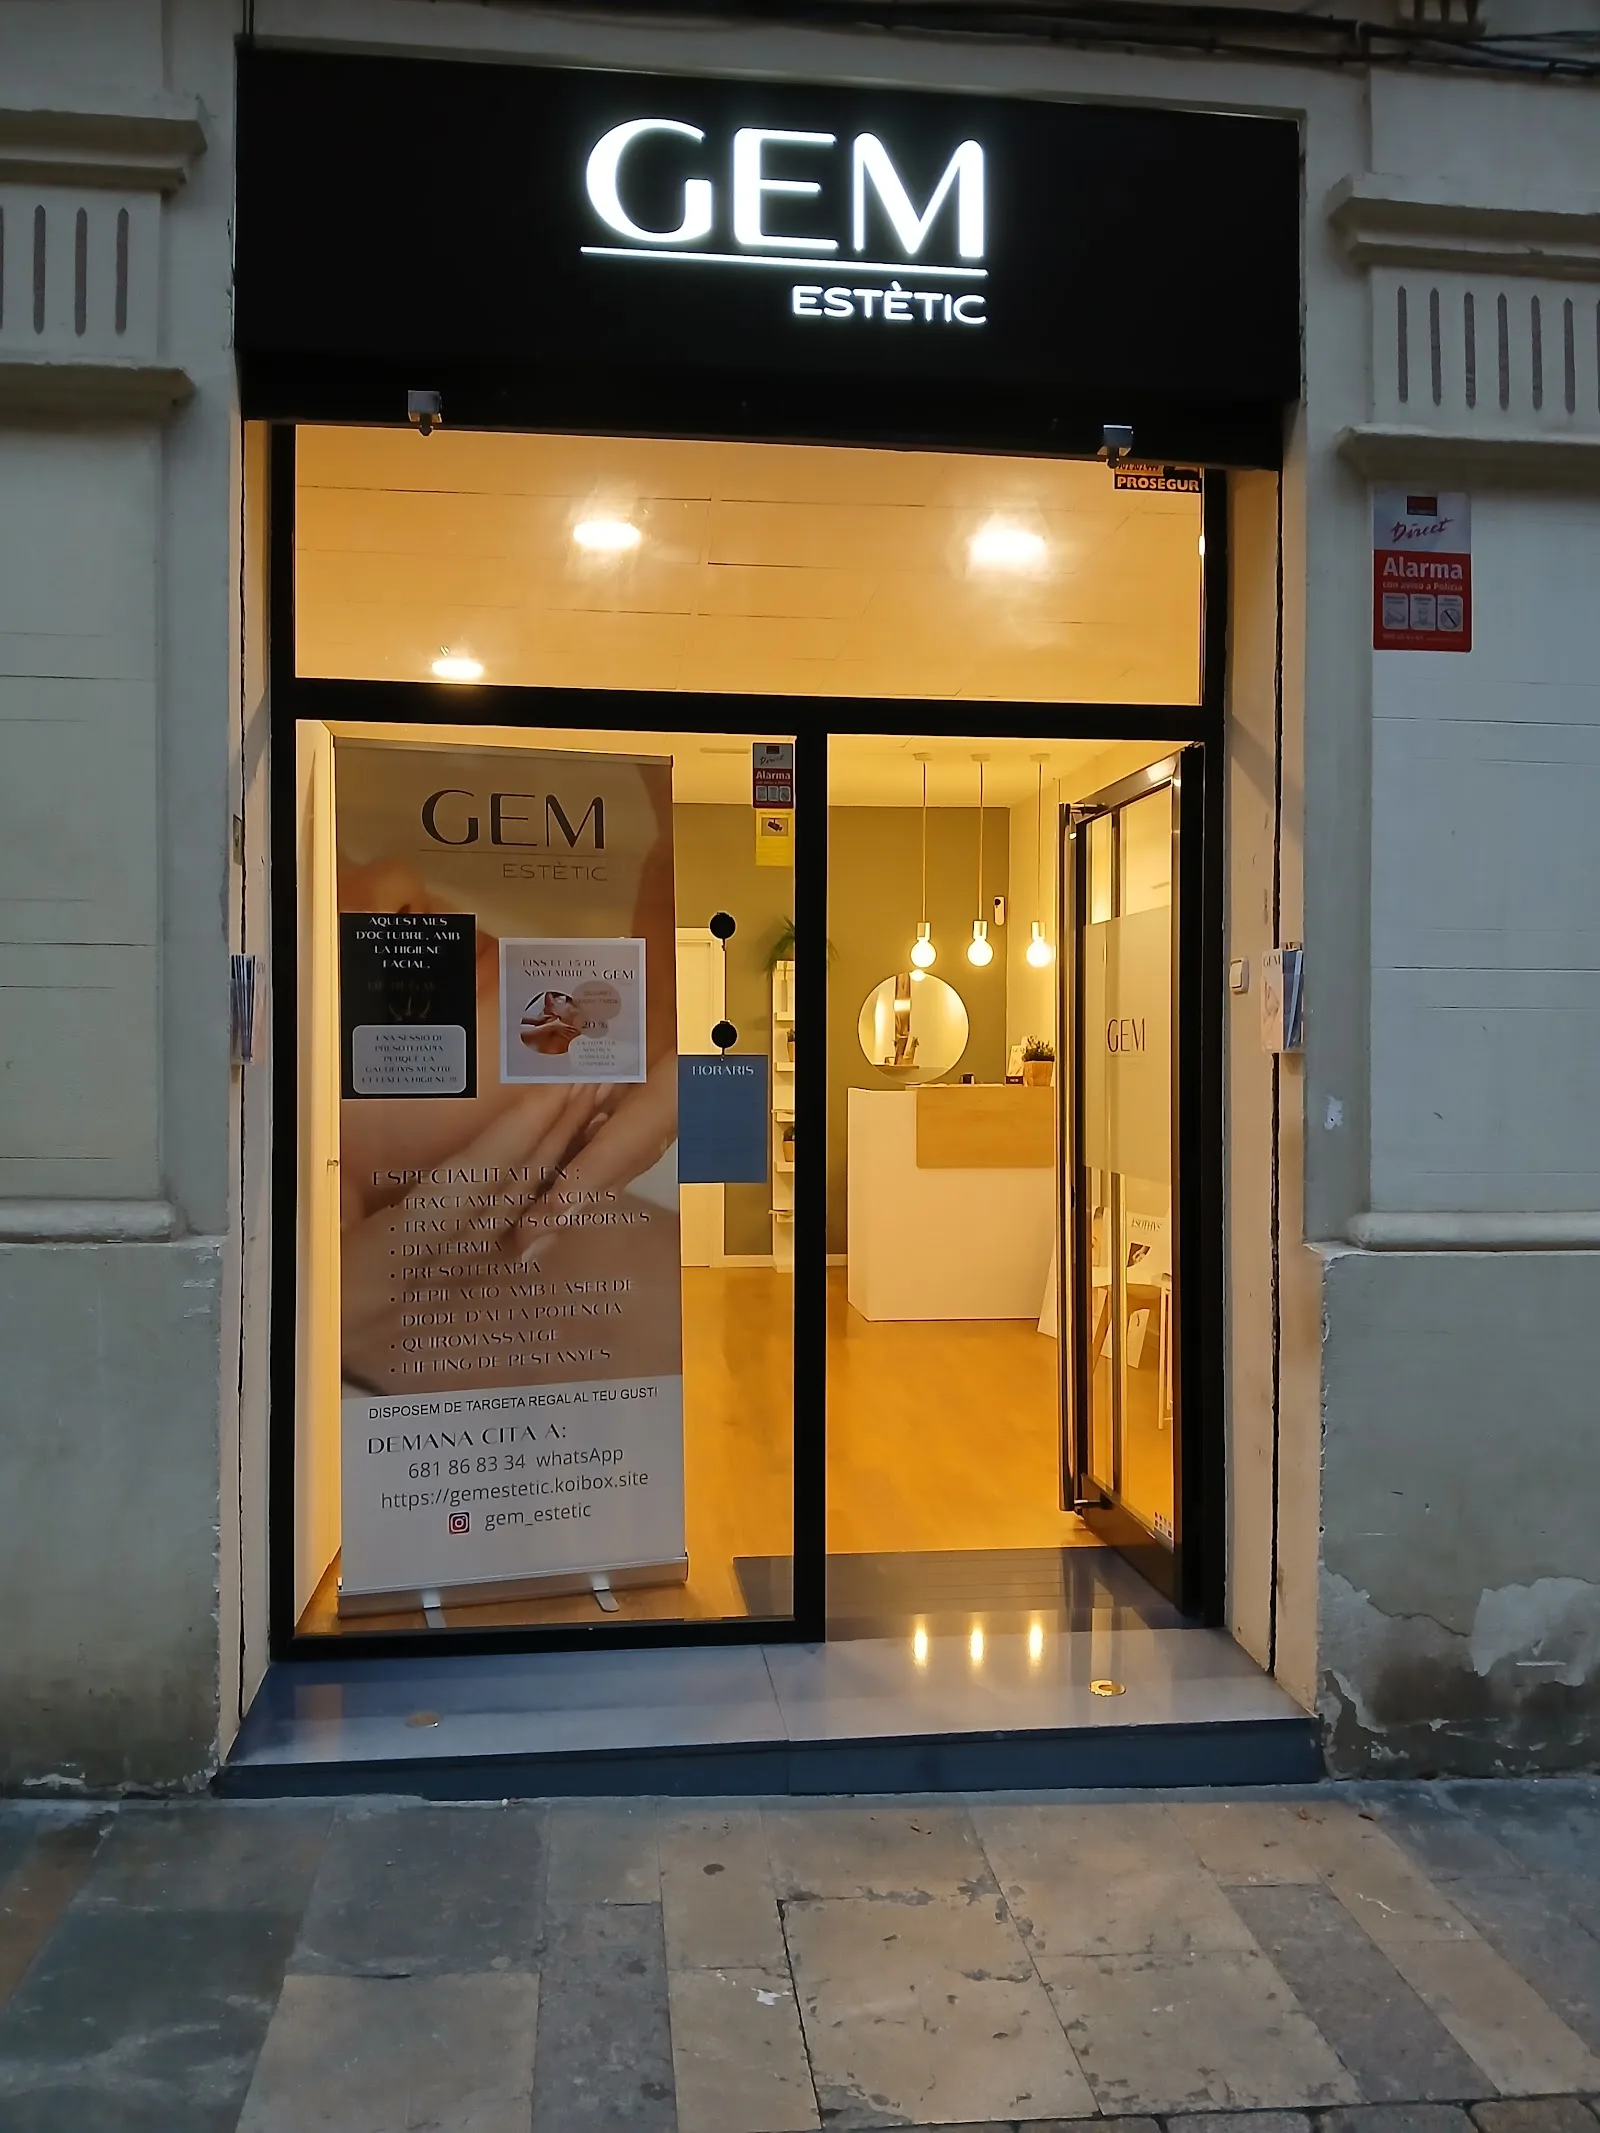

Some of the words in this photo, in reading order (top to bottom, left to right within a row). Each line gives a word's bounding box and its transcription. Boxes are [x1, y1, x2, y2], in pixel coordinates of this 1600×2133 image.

[586, 118, 985, 258] GEM
[792, 281, 987, 324] ESTÈTIC
[1117, 476, 1199, 492] PROSEGUR
[1389, 517, 1454, 543] Direct
[1382, 557, 1463, 579] Alarma
[755, 770, 791, 780] Alarma
[421, 789, 605, 849] GEM
[502, 861, 608, 882] ESTÈTIC
[433, 931, 461, 941] AMB
[374, 945, 391, 954] LA
[602, 969, 635, 980] GEM
[581, 1020, 596, 1029] 20
[1107, 1017, 1145, 1053] GEM
[691, 1065, 754, 1076] HORARIS
[373, 1166, 531, 1186] ESPECIALITAT
[404, 1193, 538, 1210] TRACTAMENTS
[544, 1190, 617, 1204] FACIALS
[404, 1215, 538, 1233] TRACTAMENTS
[543, 1211, 650, 1228] CORPORALS
[508, 1284, 546, 1298] AMB
[613, 1279, 635, 1292] DE
[403, 1328, 559, 1353] QUIROMASSATGE
[403, 1357, 472, 1374] LIFTING
[478, 1355, 500, 1369] DE
[508, 1348, 611, 1367] PESTANYES
[369, 1402, 440, 1420] DISPOSEM
[445, 1401, 462, 1414] DE
[466, 1396, 526, 1412] TARGETA
[528, 1393, 571, 1408] REGAL
[573, 1391, 589, 1404] AL
[592, 1389, 617, 1402] TEU
[368, 1430, 474, 1455] DEMANA
[481, 1425, 537, 1446] CITA
[545, 1423, 568, 1439] A:
[408, 1461, 440, 1479] 681
[448, 1458, 471, 1475] 86
[476, 1456, 498, 1473] 83
[504, 1454, 526, 1470] 34
[536, 1447, 624, 1467] whatsApp
[381, 1471, 650, 1511] https://gemestetic.koibox.site
[484, 1503, 592, 1532] gem_estetic
